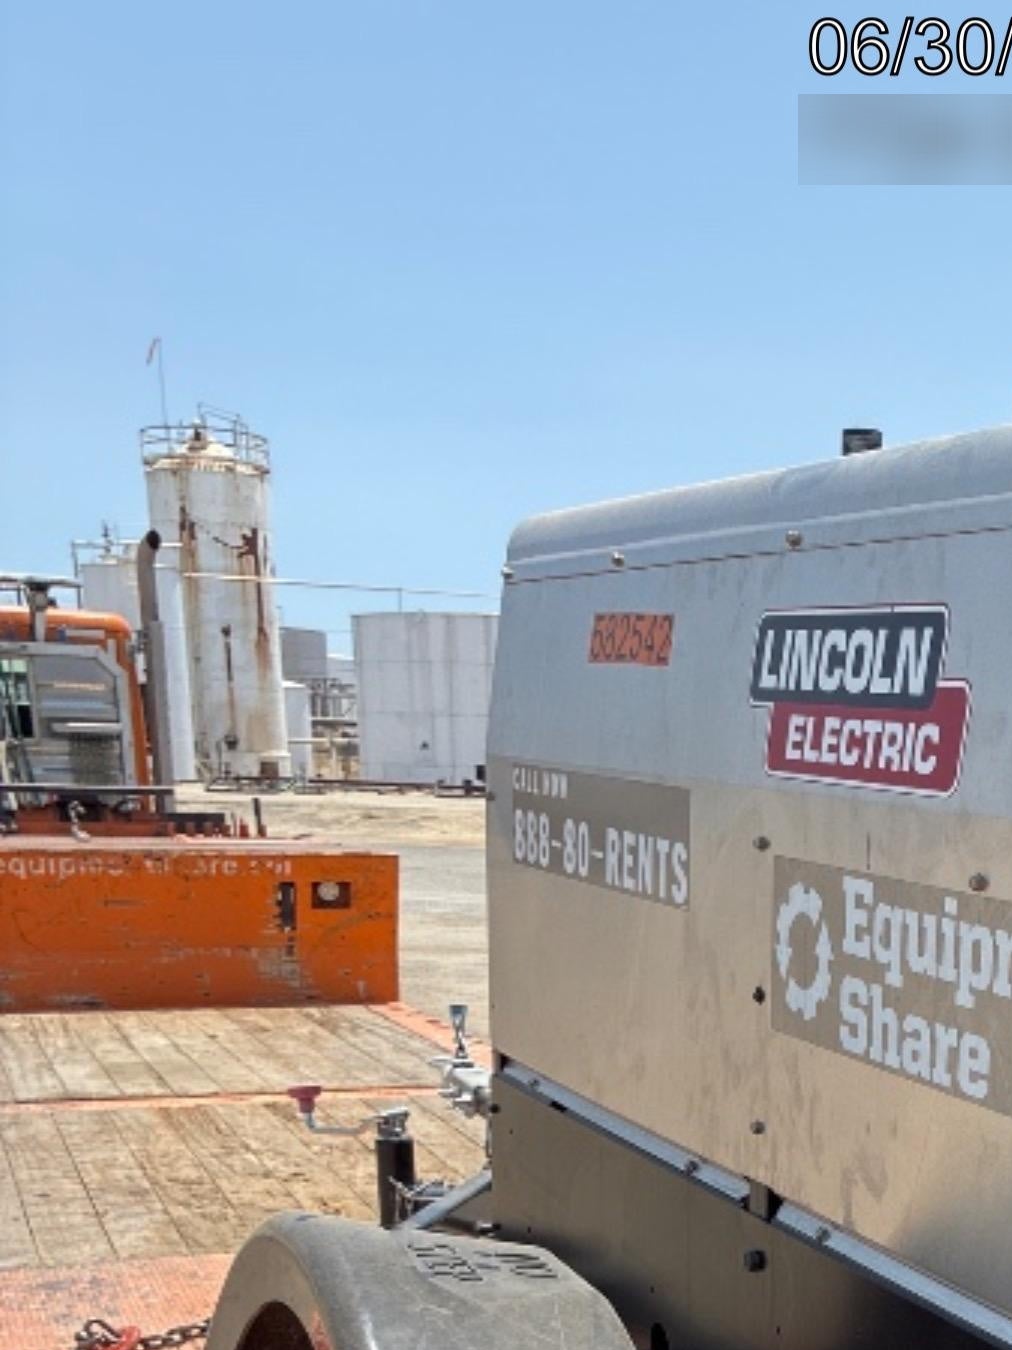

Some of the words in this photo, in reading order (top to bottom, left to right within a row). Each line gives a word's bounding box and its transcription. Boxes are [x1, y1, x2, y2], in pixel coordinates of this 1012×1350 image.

[757, 627, 934, 697] LINCOLN
[784, 714, 940, 776] ELECTRIC
[514, 808, 688, 905] 888-80-RENTS
[838, 975, 991, 1099] Share
